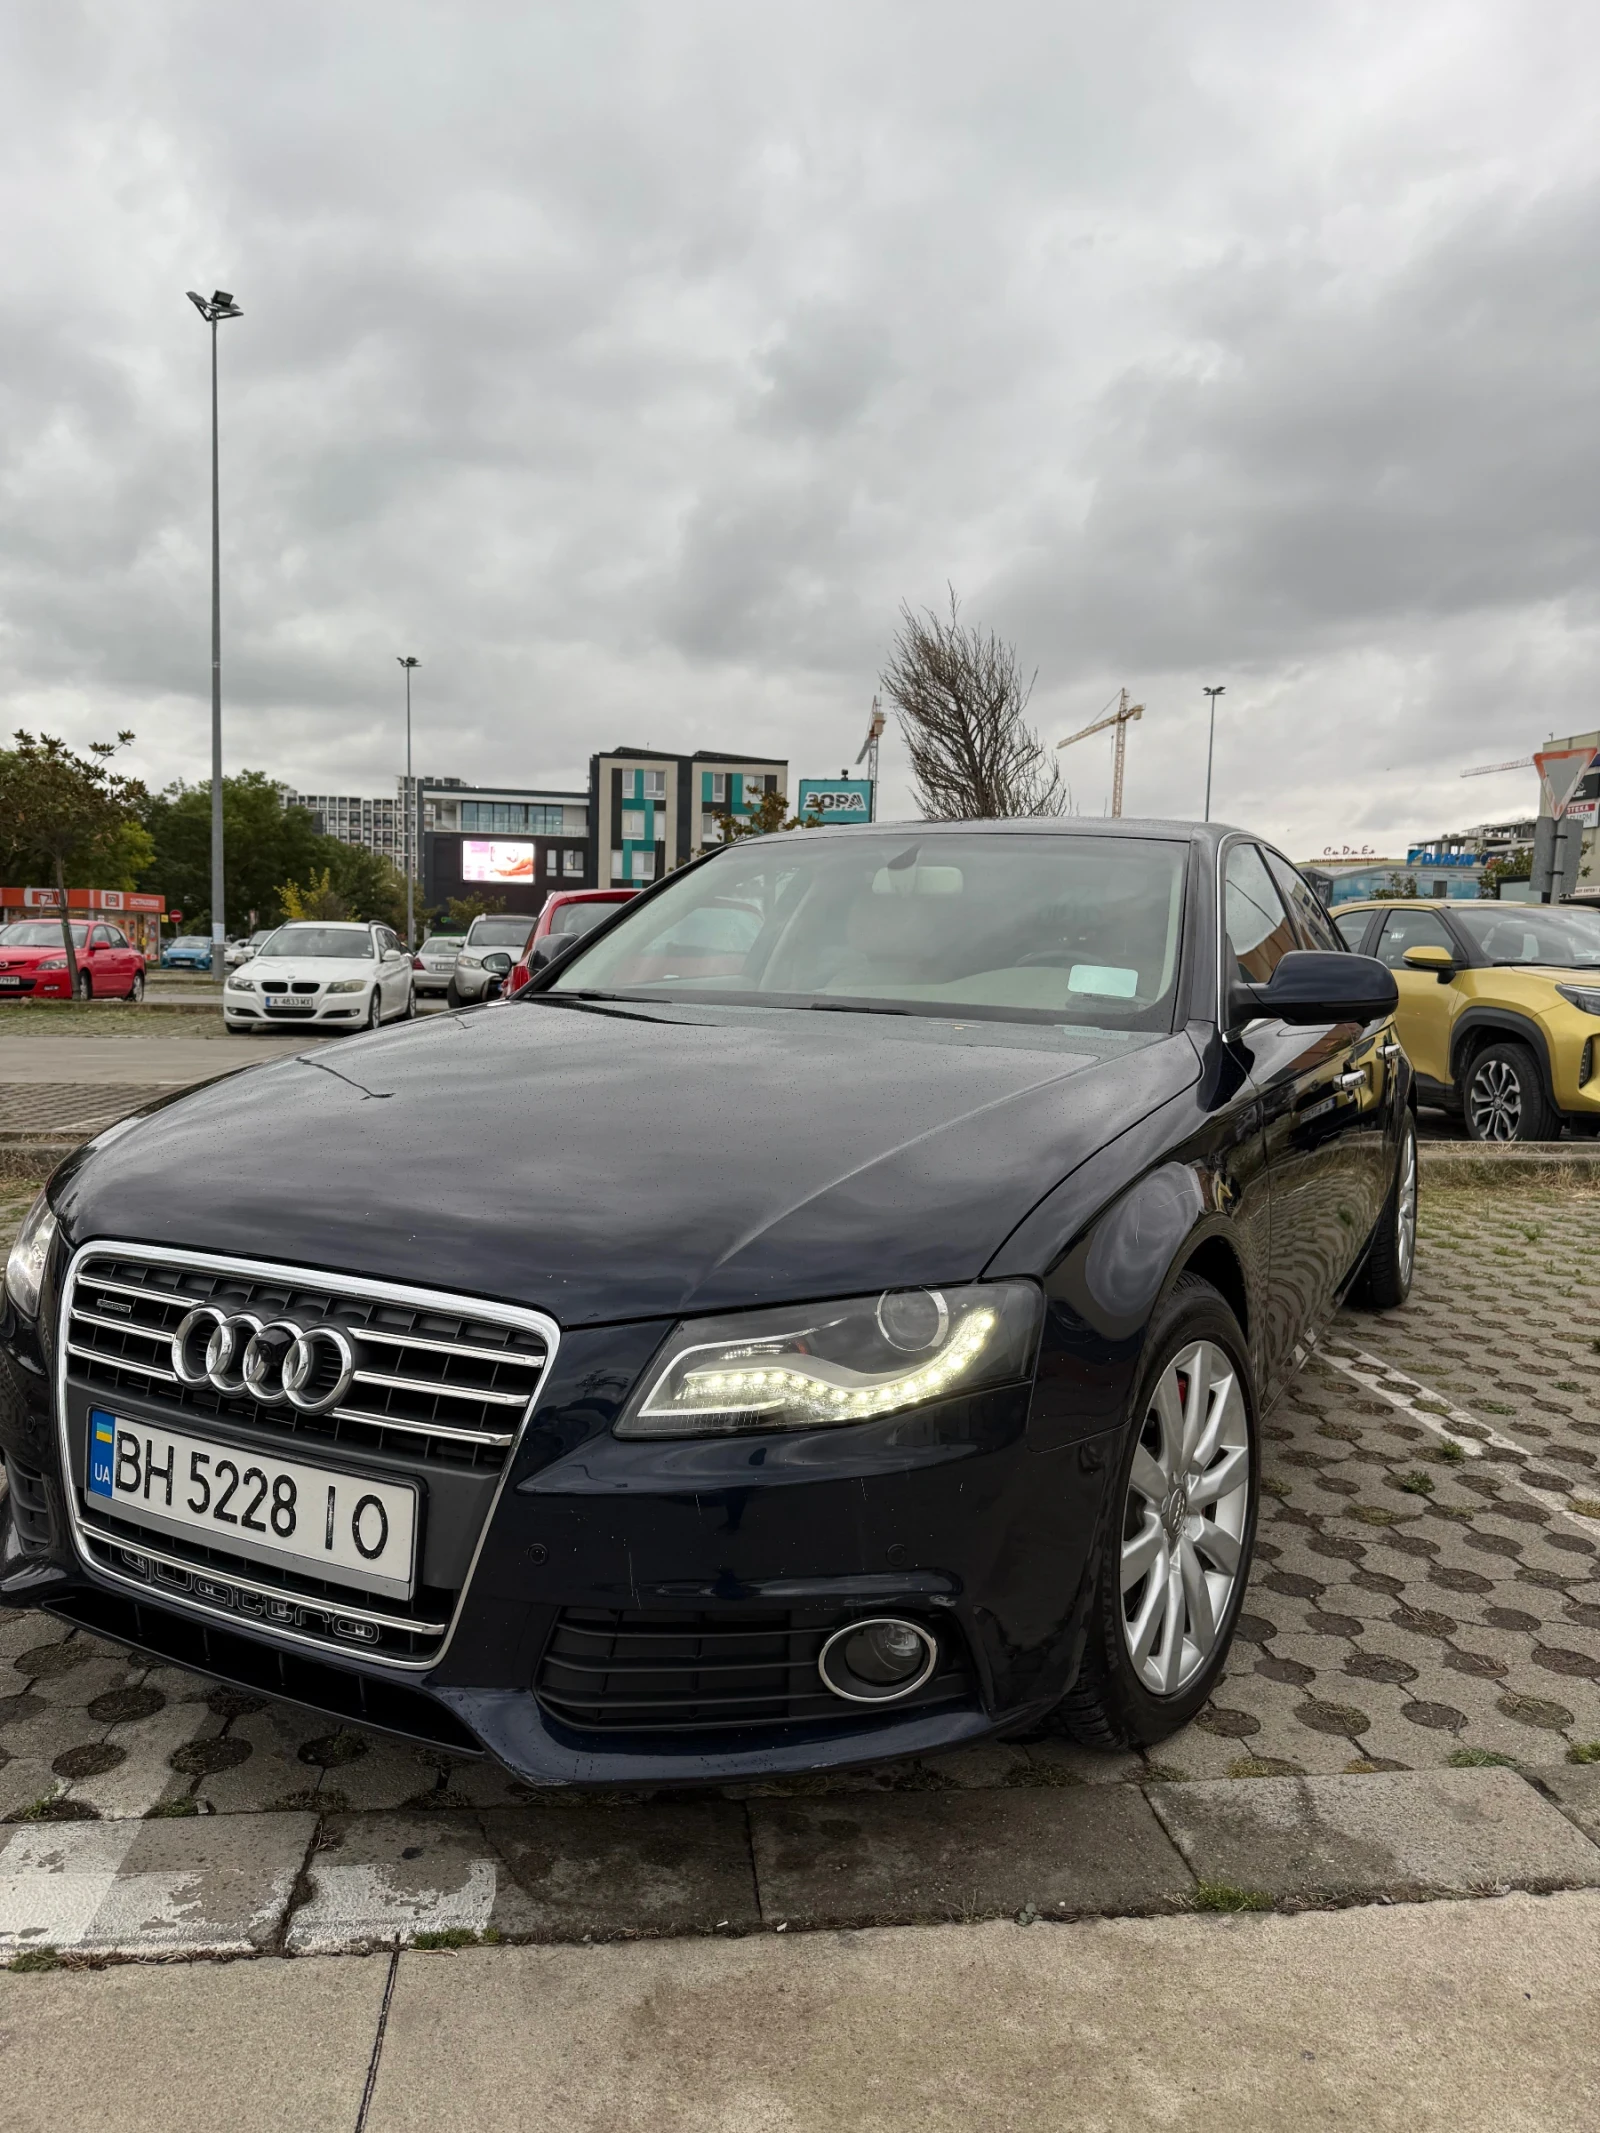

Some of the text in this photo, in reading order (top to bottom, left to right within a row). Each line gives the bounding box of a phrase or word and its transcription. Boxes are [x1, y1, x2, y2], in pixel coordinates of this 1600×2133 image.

[803, 792, 866, 811] ЗОРА
[1421, 853, 1477, 866] DAIKIN
[94, 1462, 111, 1485] UA
[115, 1429, 175, 1506] BH
[187, 1451, 298, 1538] 5228
[121, 1548, 380, 1645] quattro
[1101, 1546, 1120, 1672] WINTER
